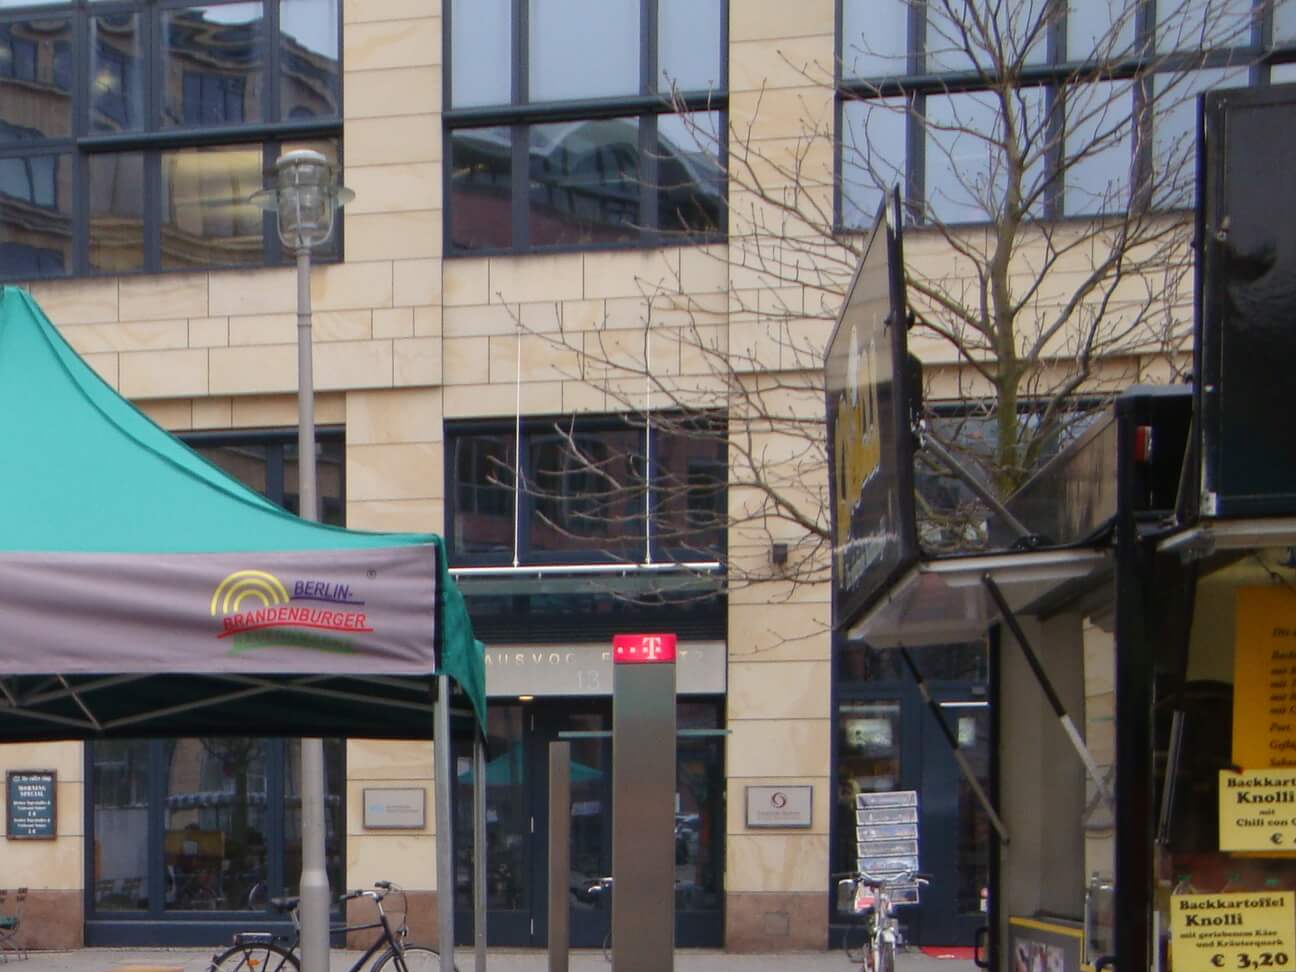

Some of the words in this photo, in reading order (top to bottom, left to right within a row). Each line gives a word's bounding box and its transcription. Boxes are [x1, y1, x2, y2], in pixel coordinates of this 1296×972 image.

[294, 581, 353, 599] BERLIN-
[223, 607, 367, 631] BRANDENBURGER
[1237, 790, 1294, 804] Knolli
[1236, 818, 1264, 827] Chili
[1179, 897, 1285, 910] Backkartoffel
[1185, 913, 1243, 927] Knolli
[1210, 953, 1225, 967] €
[1236, 952, 1289, 969] 3,20
